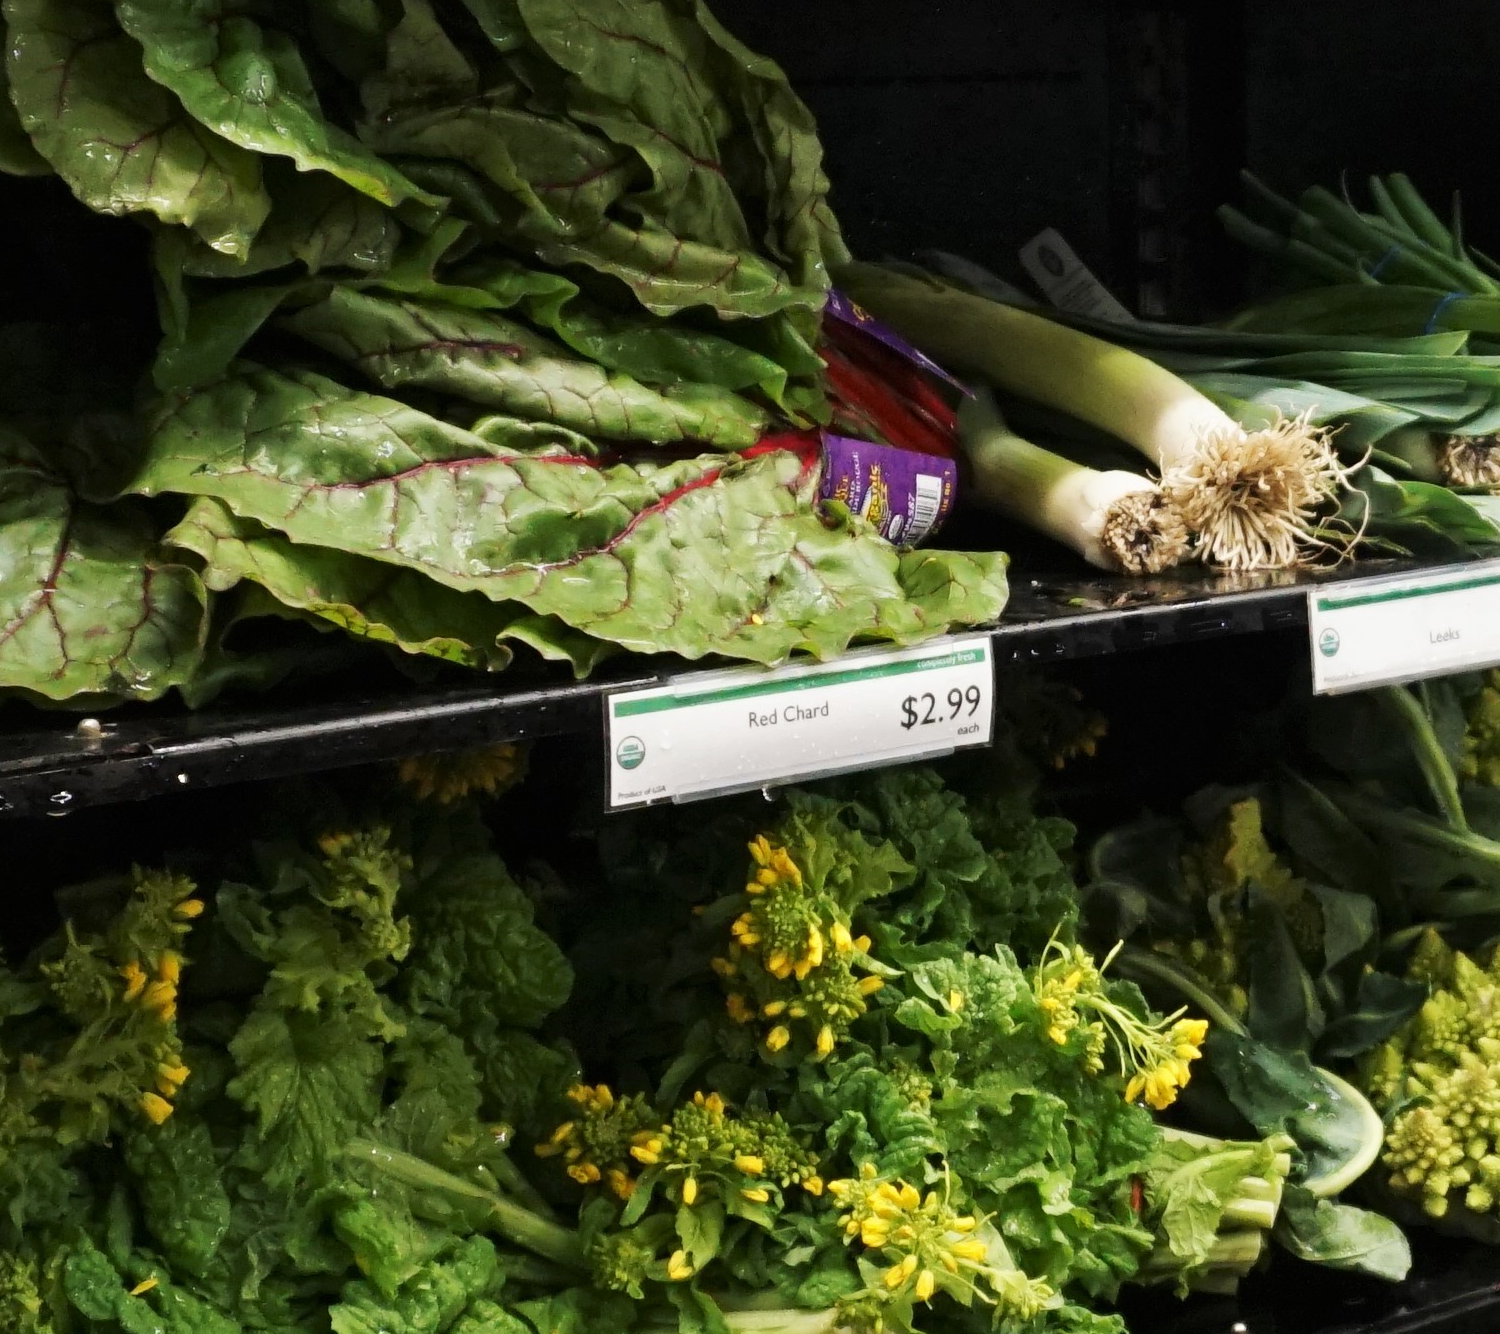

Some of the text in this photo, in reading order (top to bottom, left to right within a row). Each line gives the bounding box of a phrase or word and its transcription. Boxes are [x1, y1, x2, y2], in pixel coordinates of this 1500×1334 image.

[1429, 626, 1460, 646] Leeks
[916, 651, 976, 671] completely fresh
[748, 701, 829, 728] Red Chard
[901, 684, 981, 731] $2.99
[957, 723, 980, 736] each
[618, 789, 643, 801] Product
